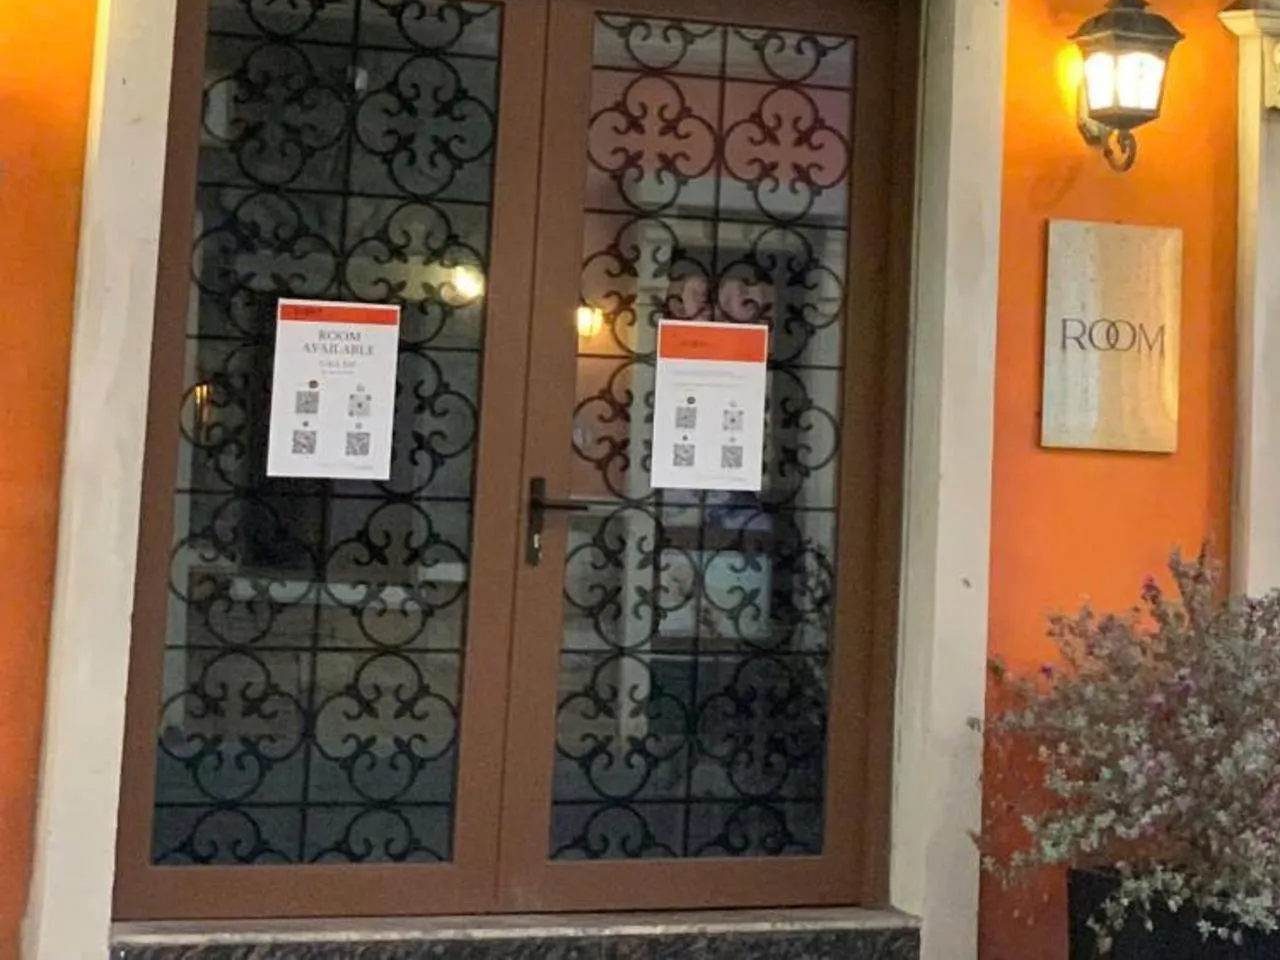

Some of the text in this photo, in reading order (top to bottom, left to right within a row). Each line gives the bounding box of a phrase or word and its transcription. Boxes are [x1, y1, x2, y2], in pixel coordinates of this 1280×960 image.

[318, 329, 361, 341] ROOM
[1061, 317, 1165, 357] ROOM
[303, 343, 374, 356] AVAILABLE
